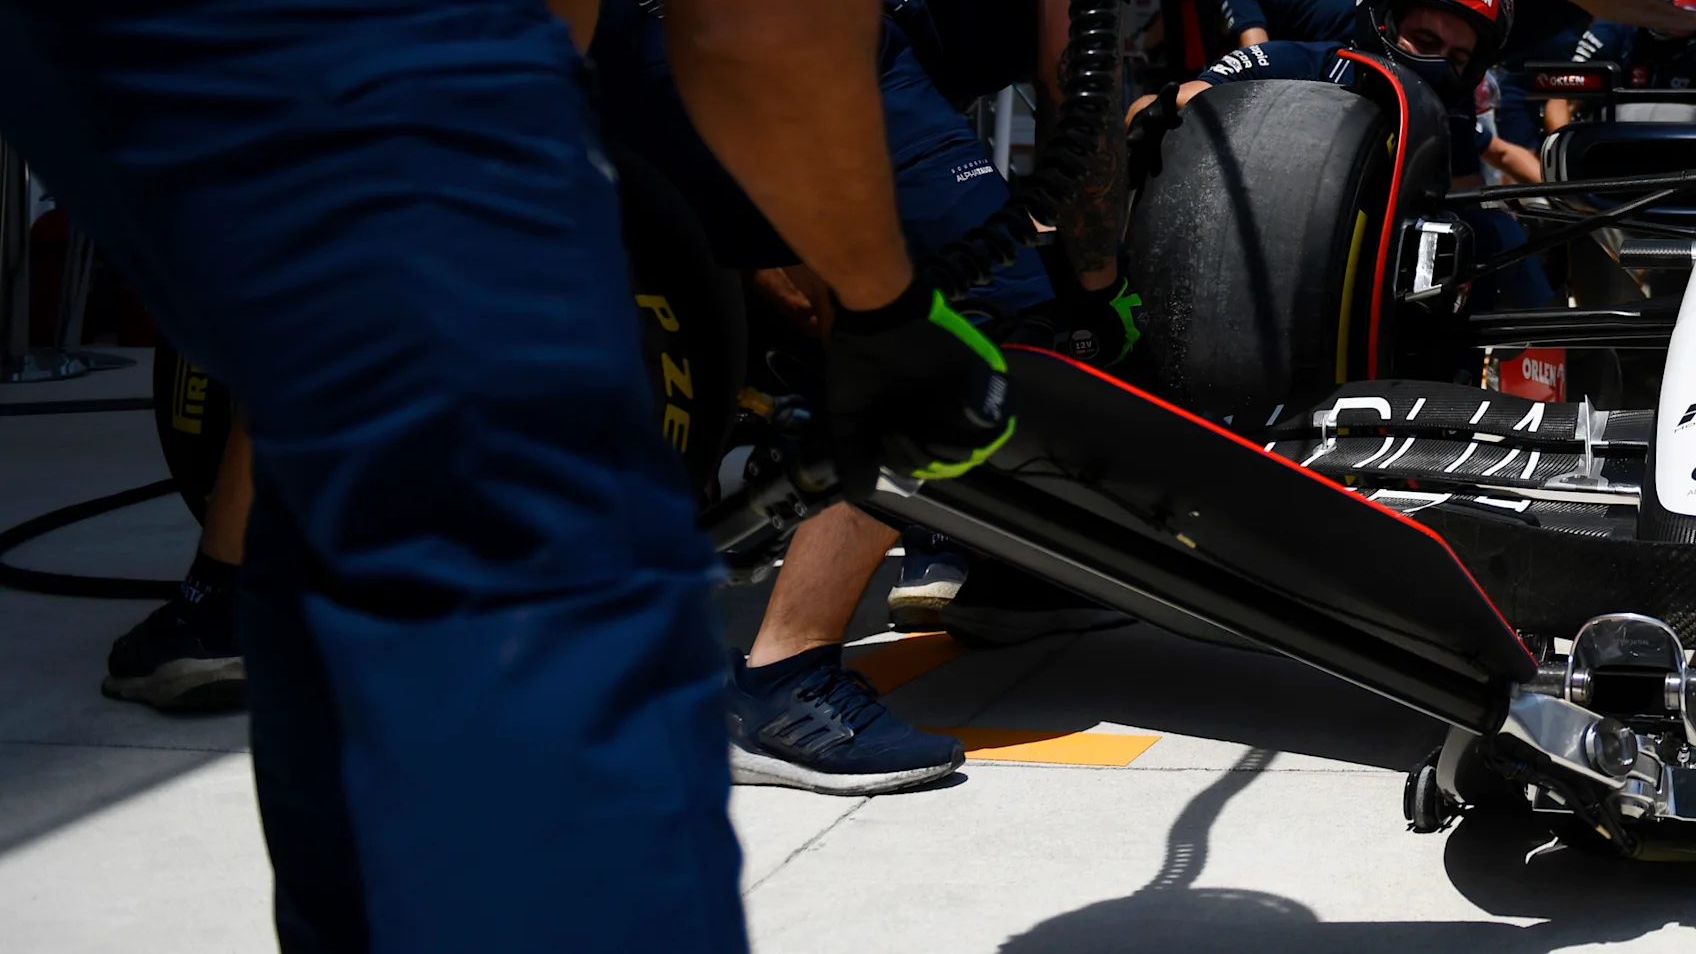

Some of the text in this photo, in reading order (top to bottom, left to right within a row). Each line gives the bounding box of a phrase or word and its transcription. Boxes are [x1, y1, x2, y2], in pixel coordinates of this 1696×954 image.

[1550, 74, 1585, 87] ORLEN
[1522, 357, 1557, 388] ORLEN
[660, 351, 694, 455] ZE
